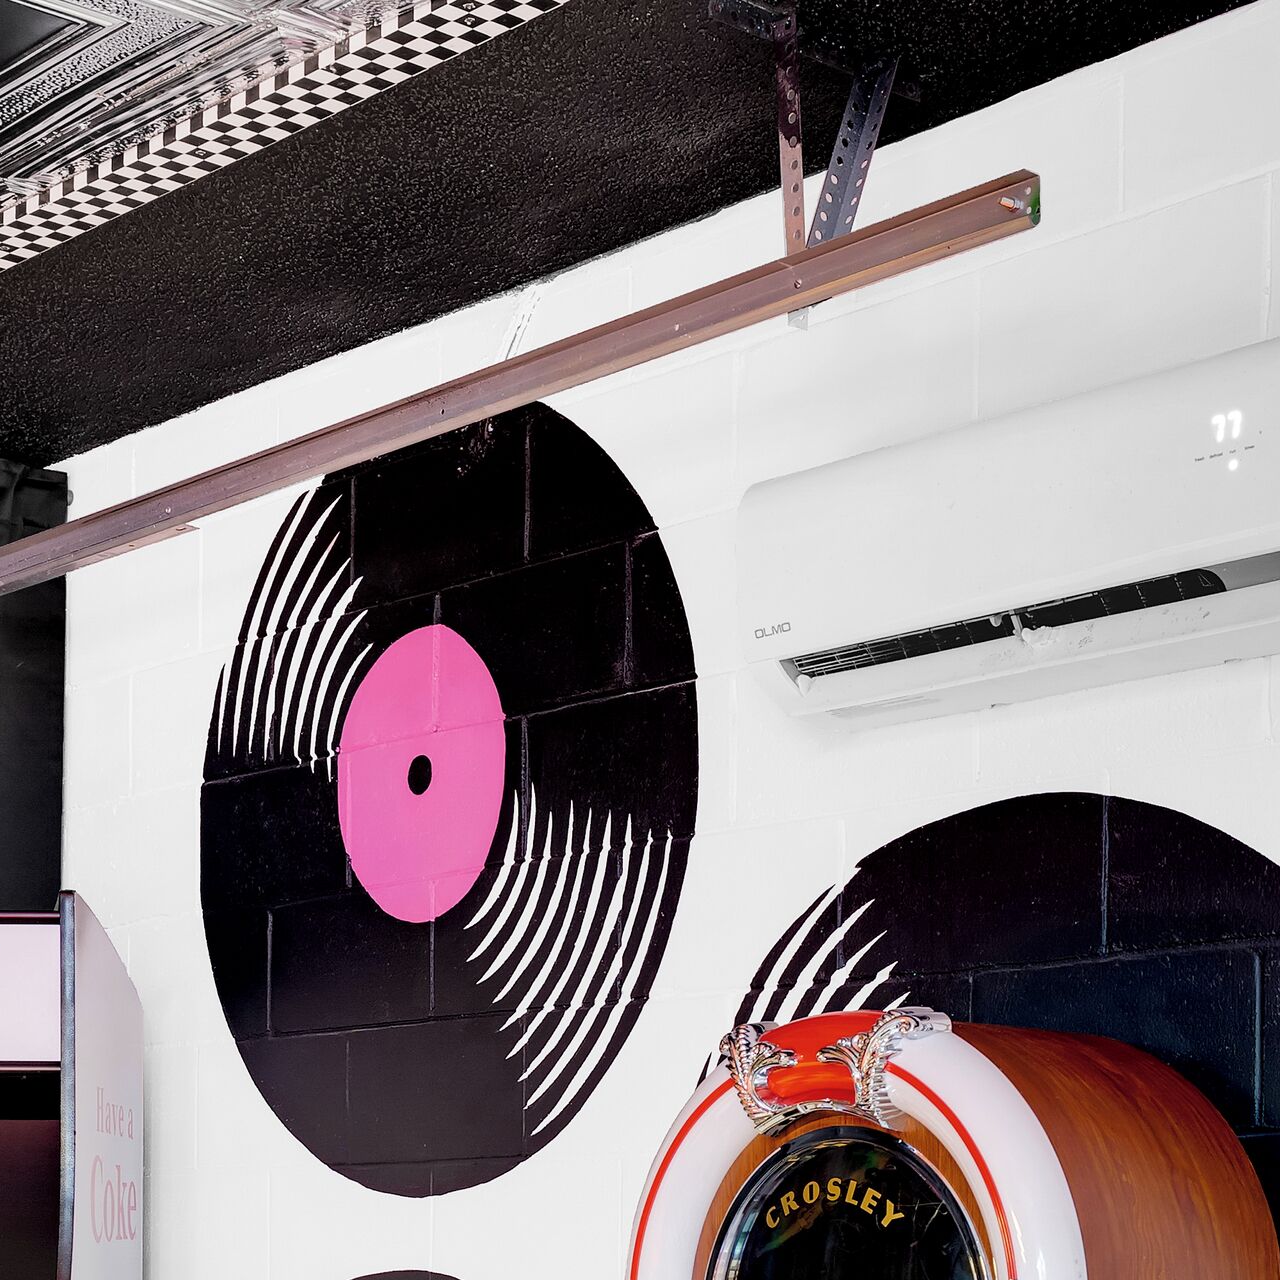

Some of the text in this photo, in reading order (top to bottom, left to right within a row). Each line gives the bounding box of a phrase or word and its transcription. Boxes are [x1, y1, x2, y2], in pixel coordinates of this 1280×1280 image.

[754, 622, 791, 639] OLMO
[96, 1086, 134, 1140] Have a
[90, 1155, 137, 1243] Coke
[765, 1177, 905, 1229] CROSLEY
